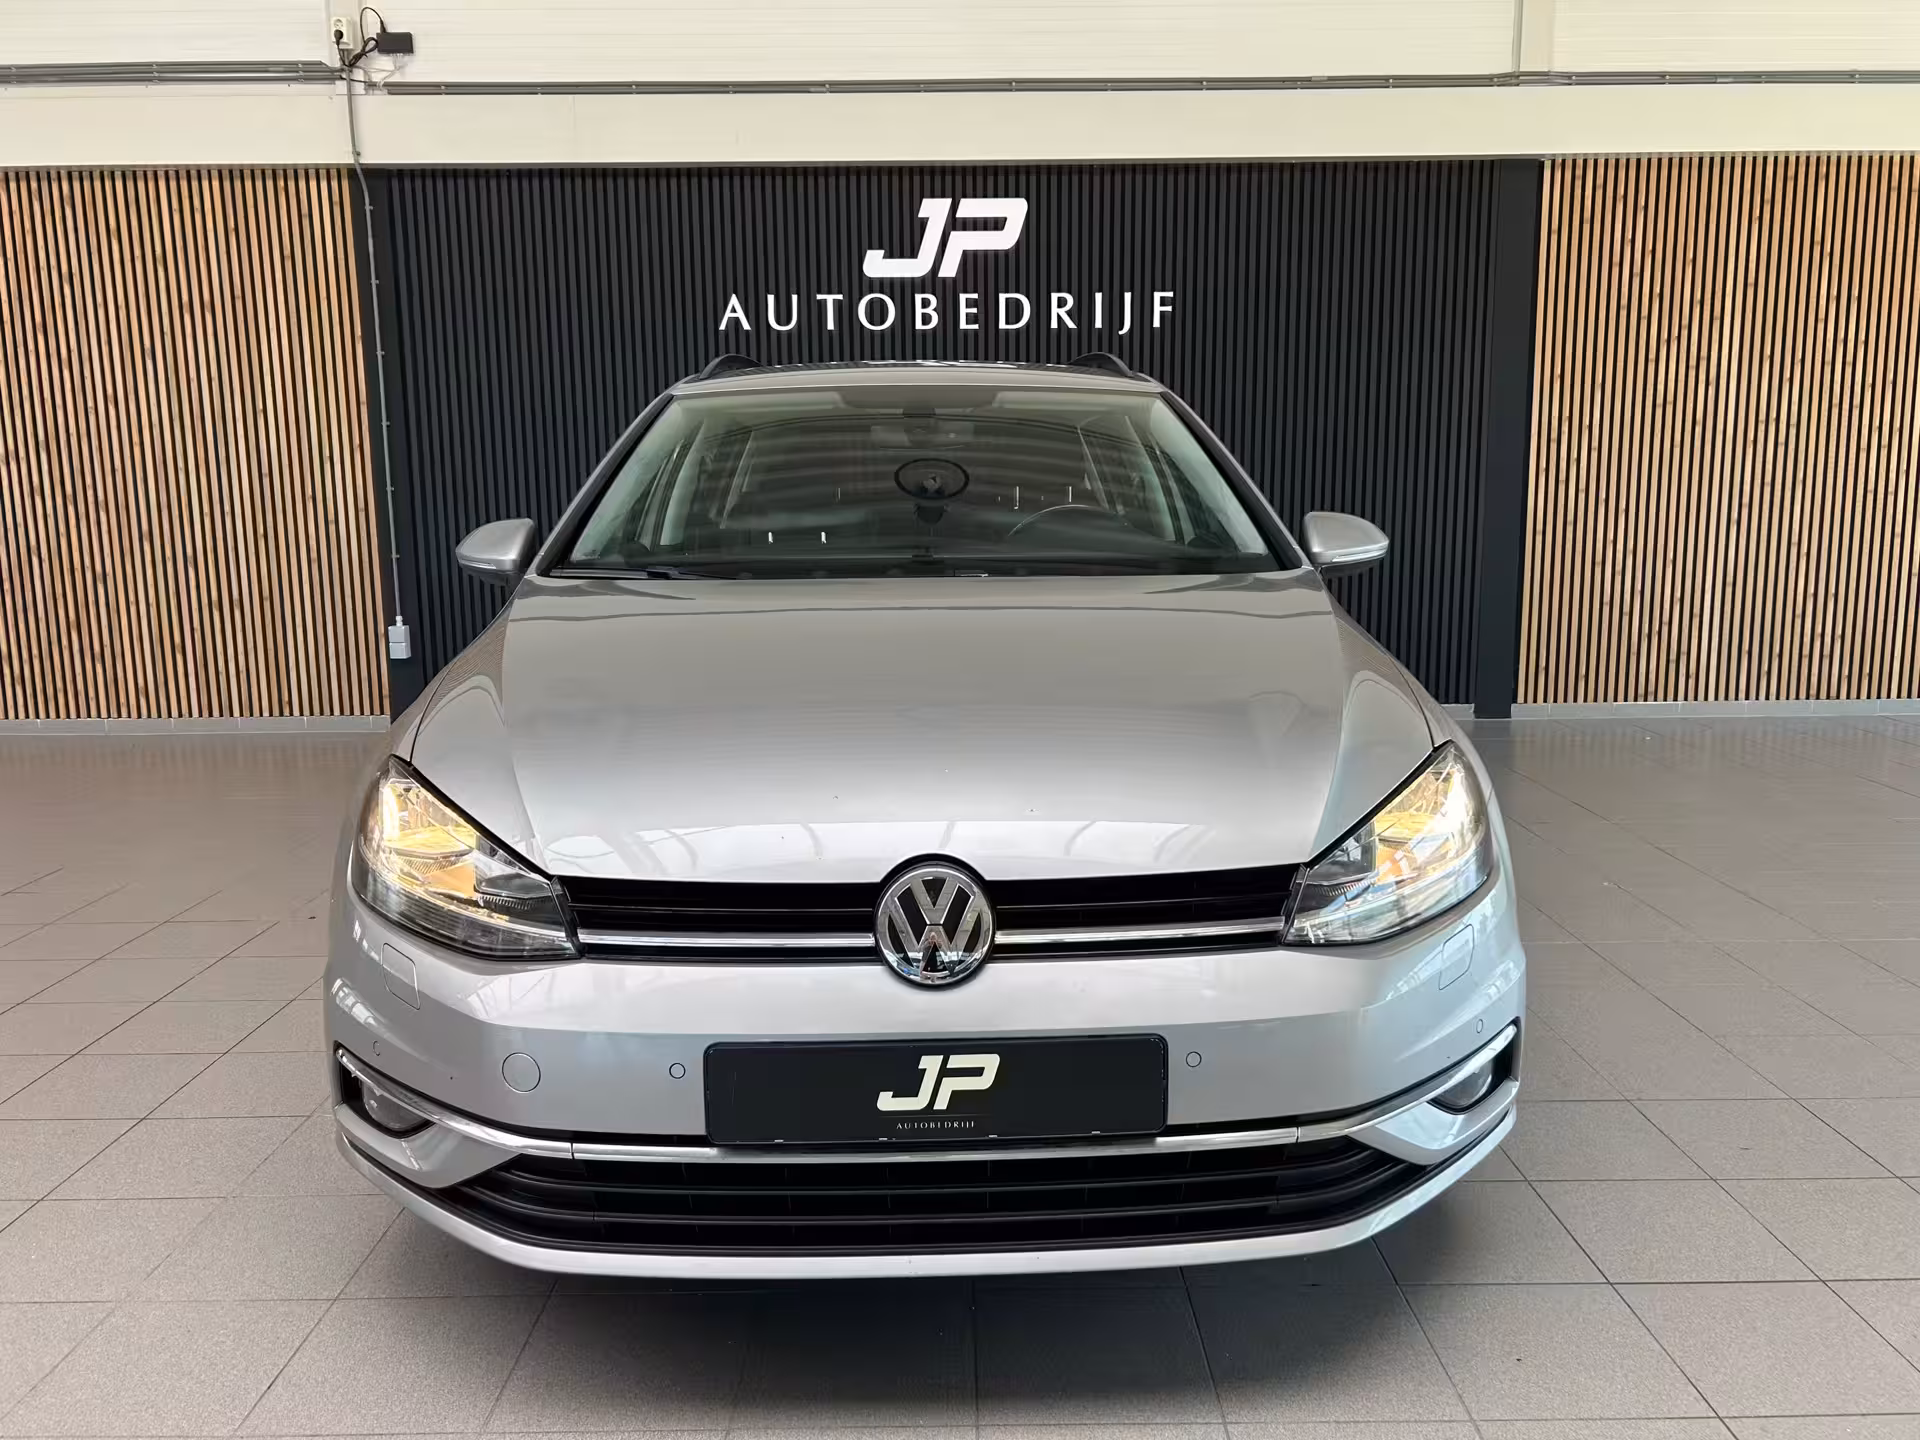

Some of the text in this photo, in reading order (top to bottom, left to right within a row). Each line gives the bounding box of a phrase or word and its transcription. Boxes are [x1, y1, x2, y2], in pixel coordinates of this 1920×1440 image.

[862, 197, 1029, 278] JP
[718, 291, 1174, 335] AUTOBEDRIJF
[882, 871, 988, 980] VW
[876, 1053, 1001, 1112] JP
